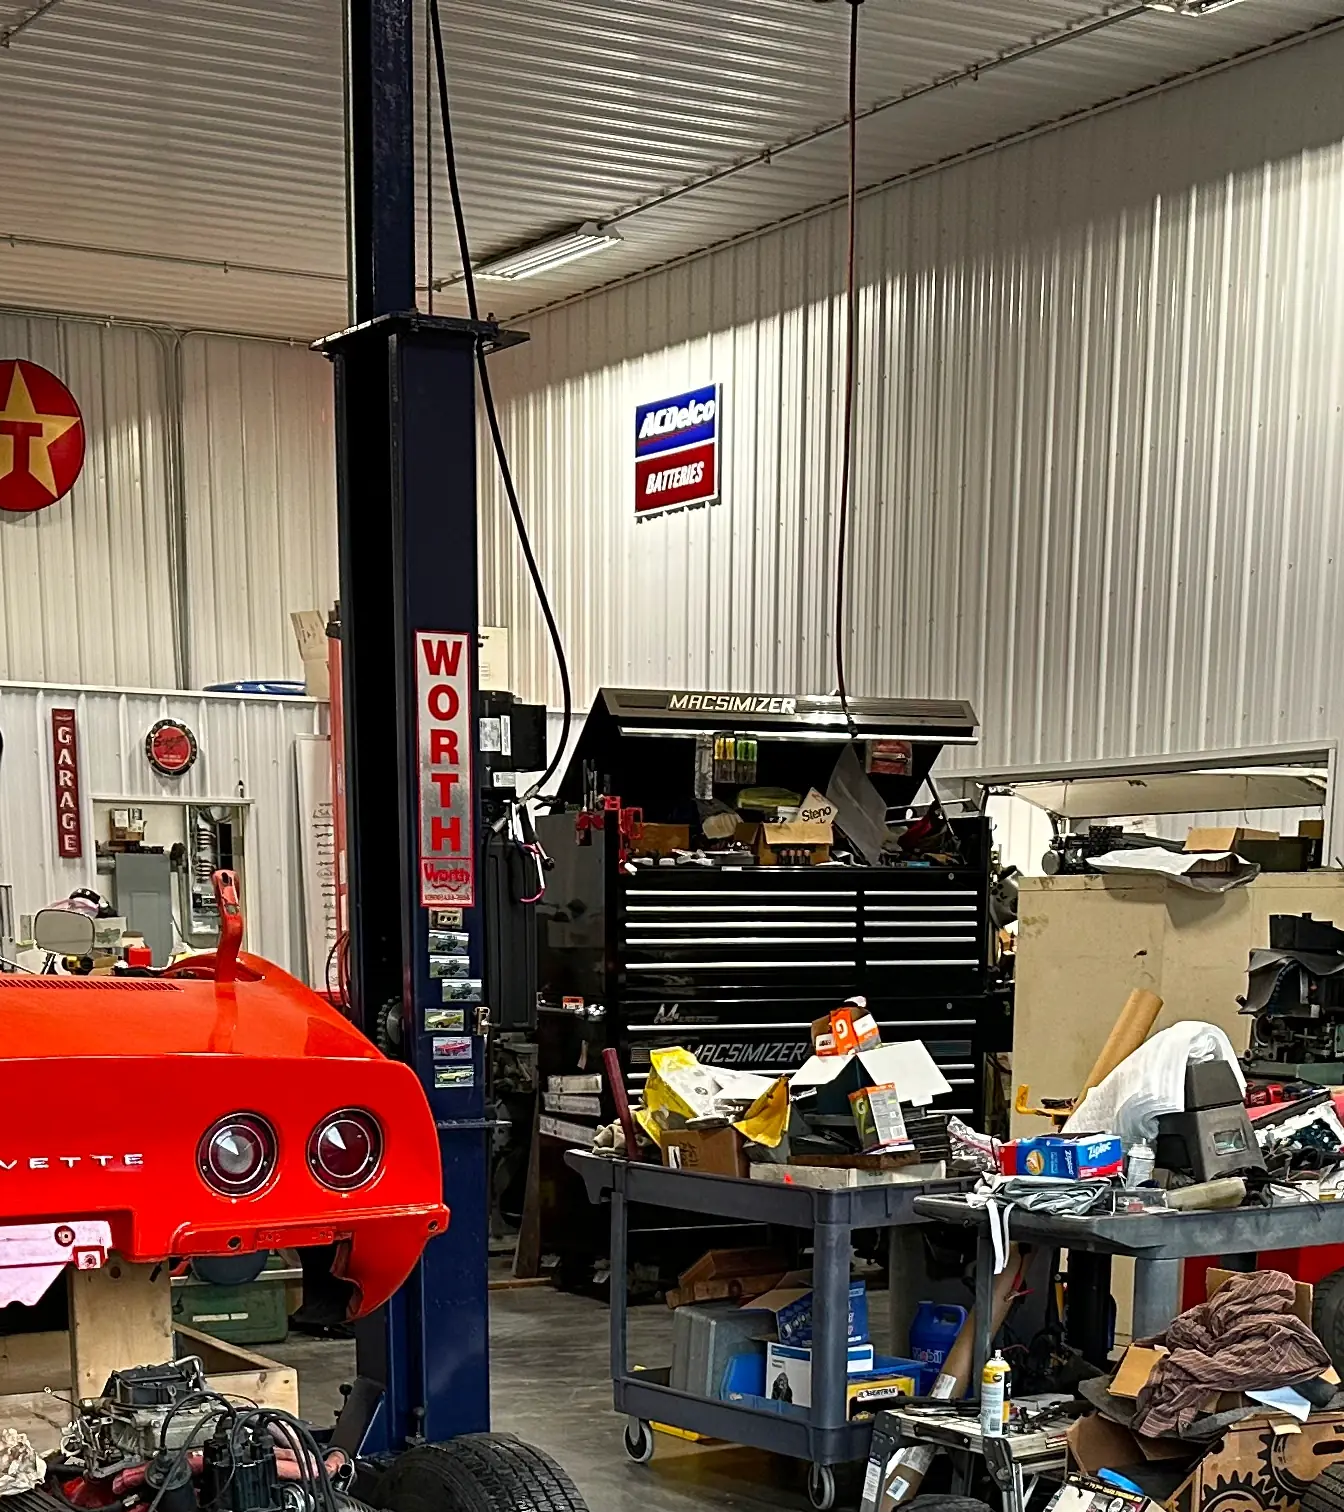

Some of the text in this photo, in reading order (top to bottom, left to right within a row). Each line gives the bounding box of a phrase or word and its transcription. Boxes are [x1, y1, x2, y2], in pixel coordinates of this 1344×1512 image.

[638, 399, 716, 439] ACDelco
[645, 461, 705, 495] BATTERIES
[669, 694, 797, 715] MACSIMIZER
[421, 639, 464, 852] WORTH
[57, 726, 77, 852] GARAGE
[801, 805, 832, 822] Steno
